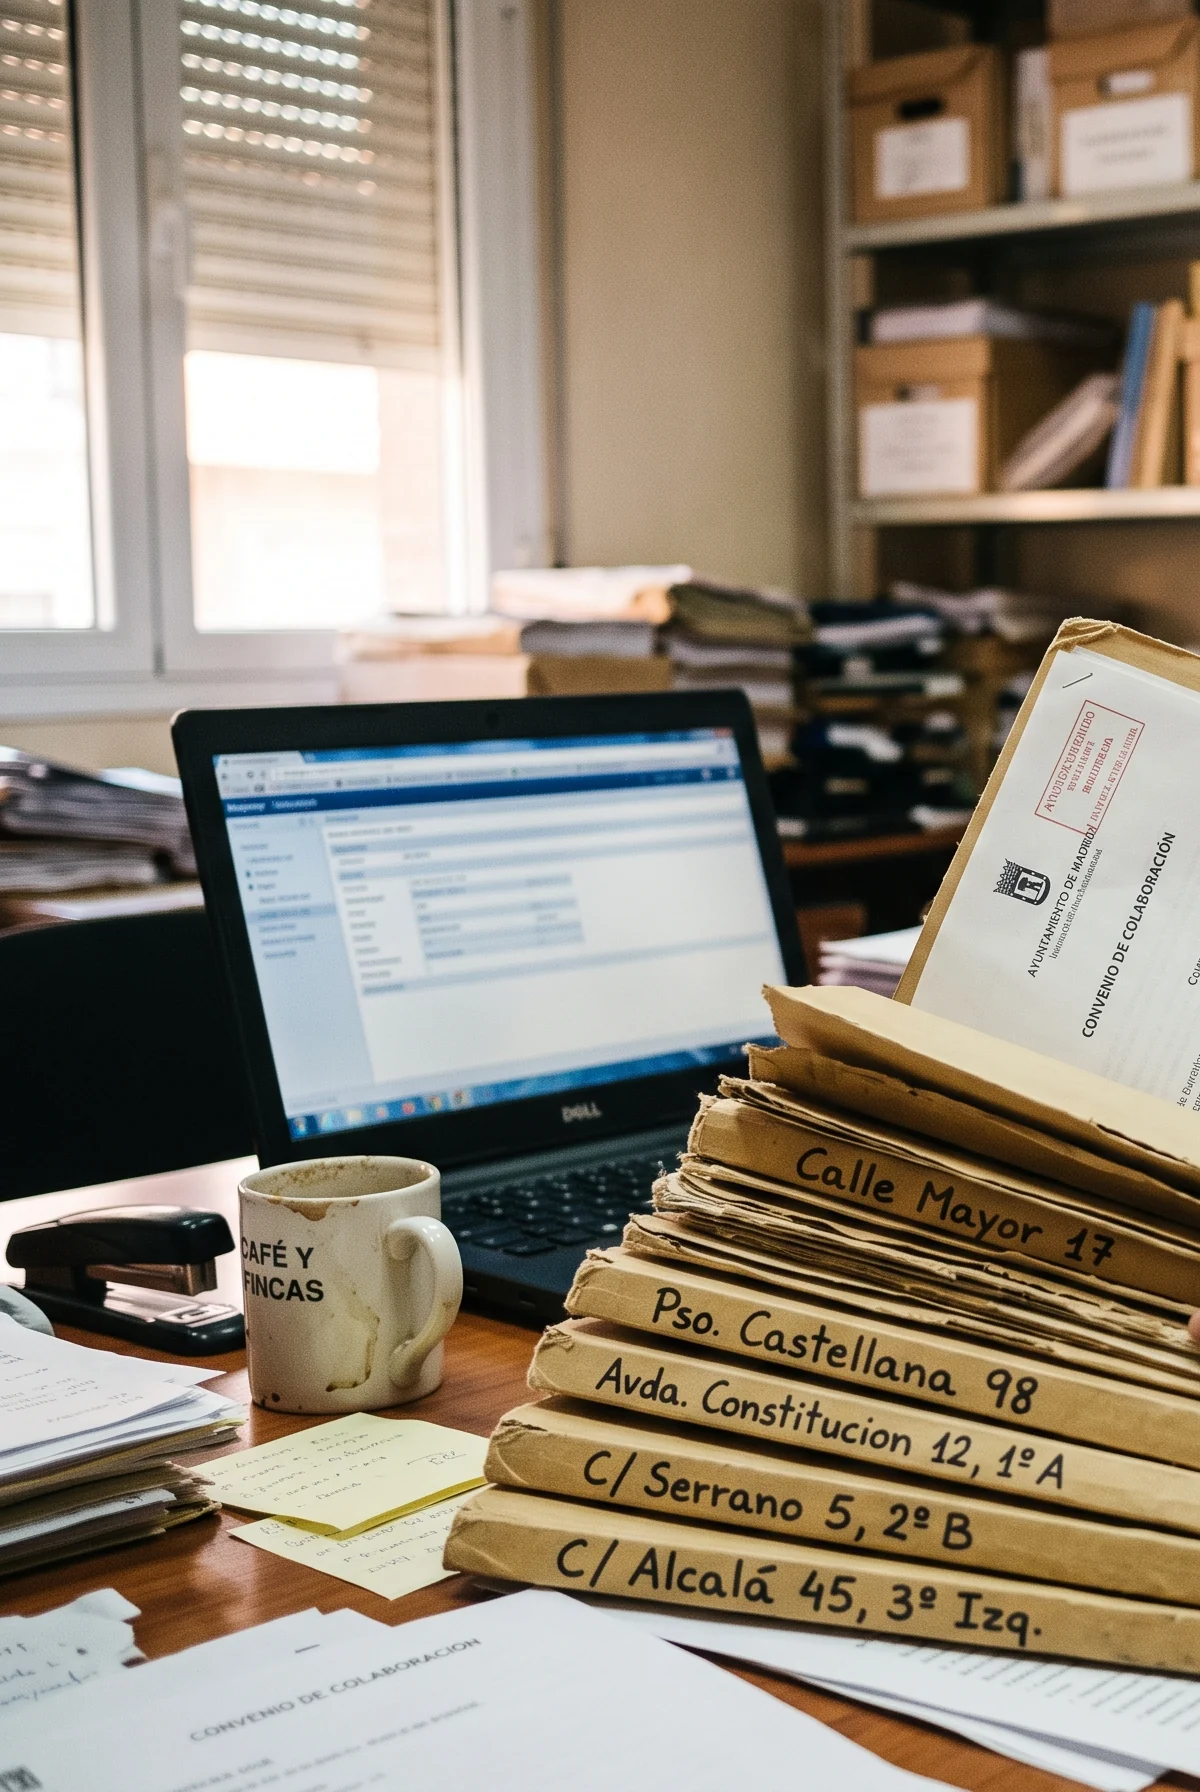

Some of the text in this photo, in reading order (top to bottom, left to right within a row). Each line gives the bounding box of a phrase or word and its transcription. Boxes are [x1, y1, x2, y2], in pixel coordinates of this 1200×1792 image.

[1026, 890, 1070, 978] AYUNTAMIENTO
[1062, 872, 1078, 890] DE
[1081, 830, 1176, 1038] CONVENIO DE COLABORACIÓN
[561, 1101, 603, 1124] DELL
[240, 1237, 315, 1269] CAFÉ Y
[795, 1147, 1117, 1266] Calle Mayor 17
[244, 1269, 324, 1302] FINCAS
[650, 1288, 1039, 1415] Pso. Castellana 98
[596, 1357, 689, 1408] Avda.
[702, 1380, 911, 1456] Constitucion
[930, 1432, 980, 1479] 12,
[1036, 1454, 1065, 1490] A
[583, 1450, 638, 1498] C/
[644, 1462, 804, 1522] Serrano
[825, 1494, 866, 1543] 5,
[941, 1512, 974, 1551] B
[556, 1538, 620, 1587] C/
[628, 1548, 777, 1604] Alcalá
[798, 1570, 868, 1625] 45,
[954, 1592, 1043, 1650] Izq.
[189, 1700, 296, 1742] CONVENIO
[298, 1690, 328, 1706] DE
